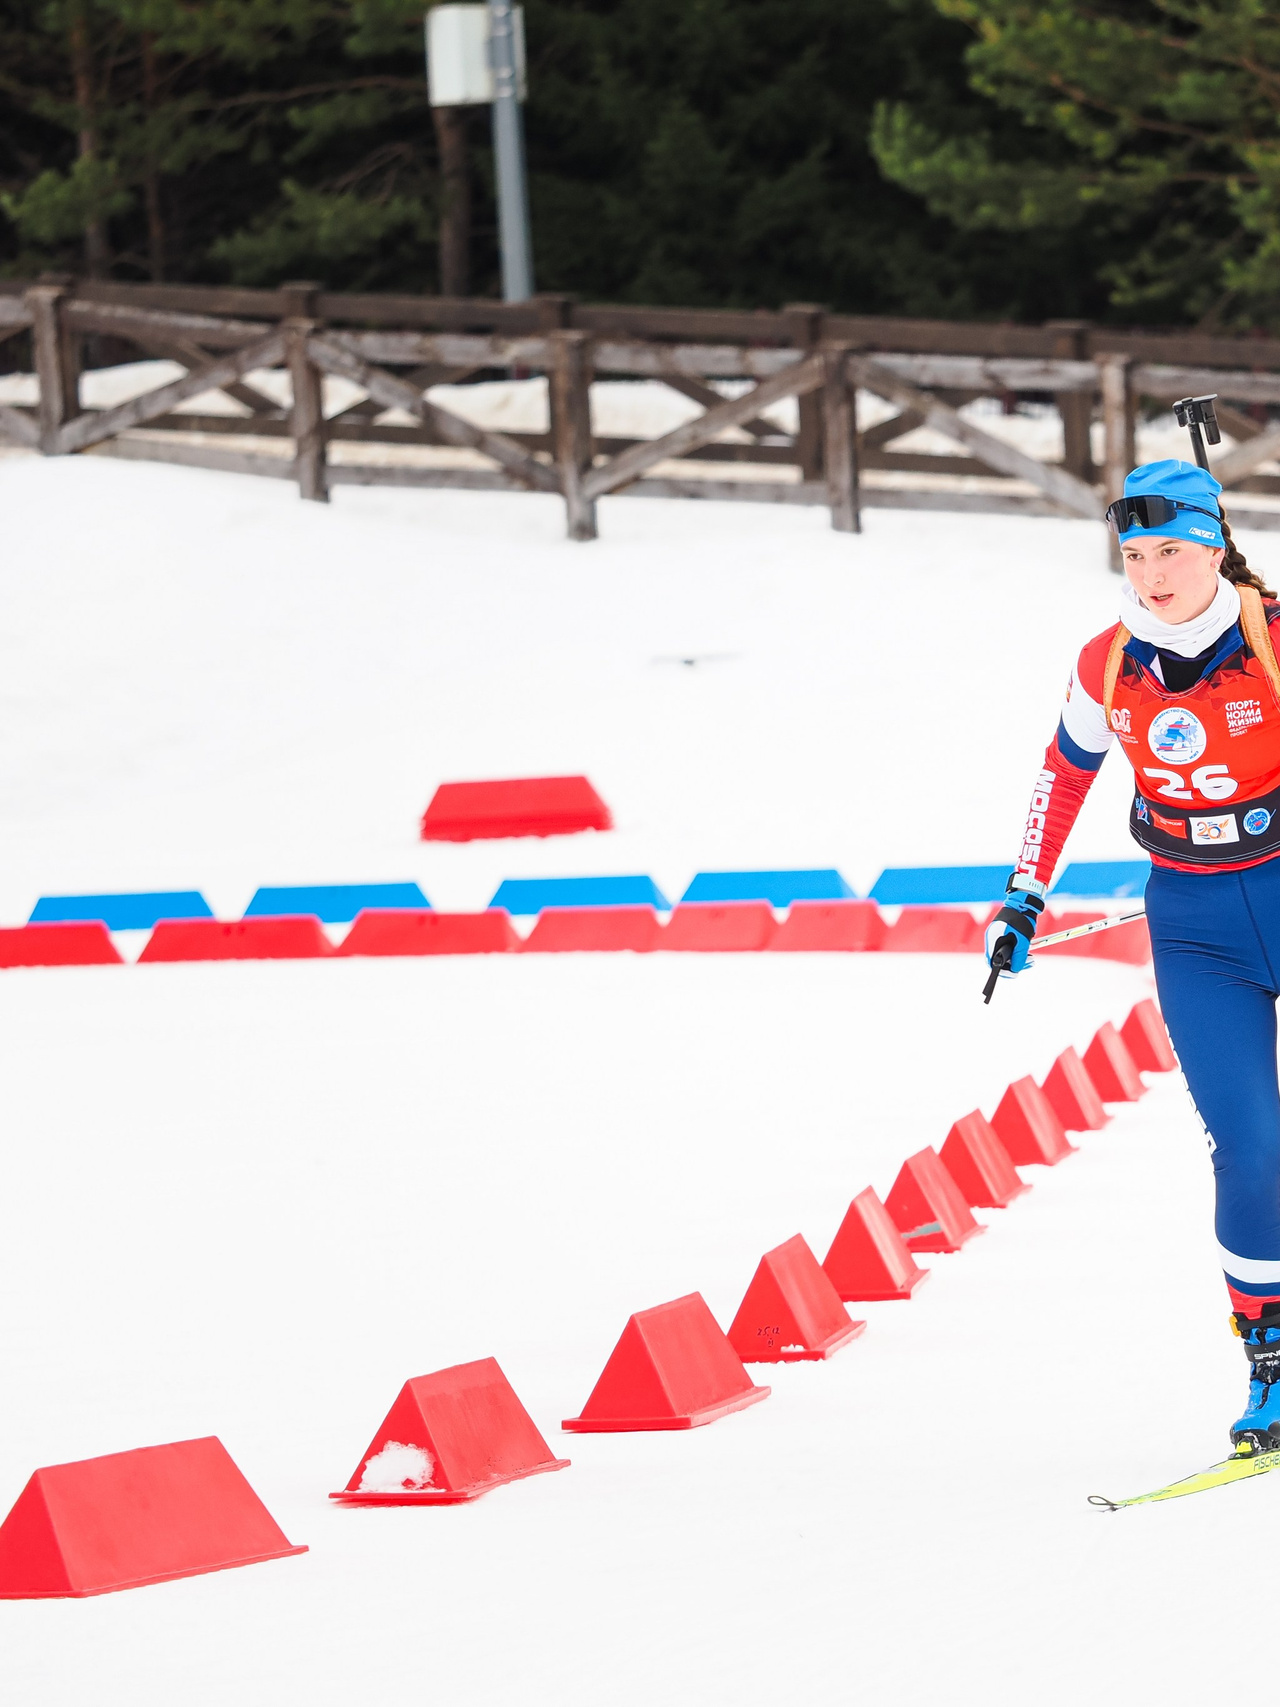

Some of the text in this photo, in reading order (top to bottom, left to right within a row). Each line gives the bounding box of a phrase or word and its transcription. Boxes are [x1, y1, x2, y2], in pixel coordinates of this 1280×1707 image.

[1225, 700, 1254, 711] СПОРТ
[1226, 708, 1262, 720] НОРМА
[1228, 715, 1263, 728] ЖИЗНИ
[1142, 764, 1239, 801] 26
